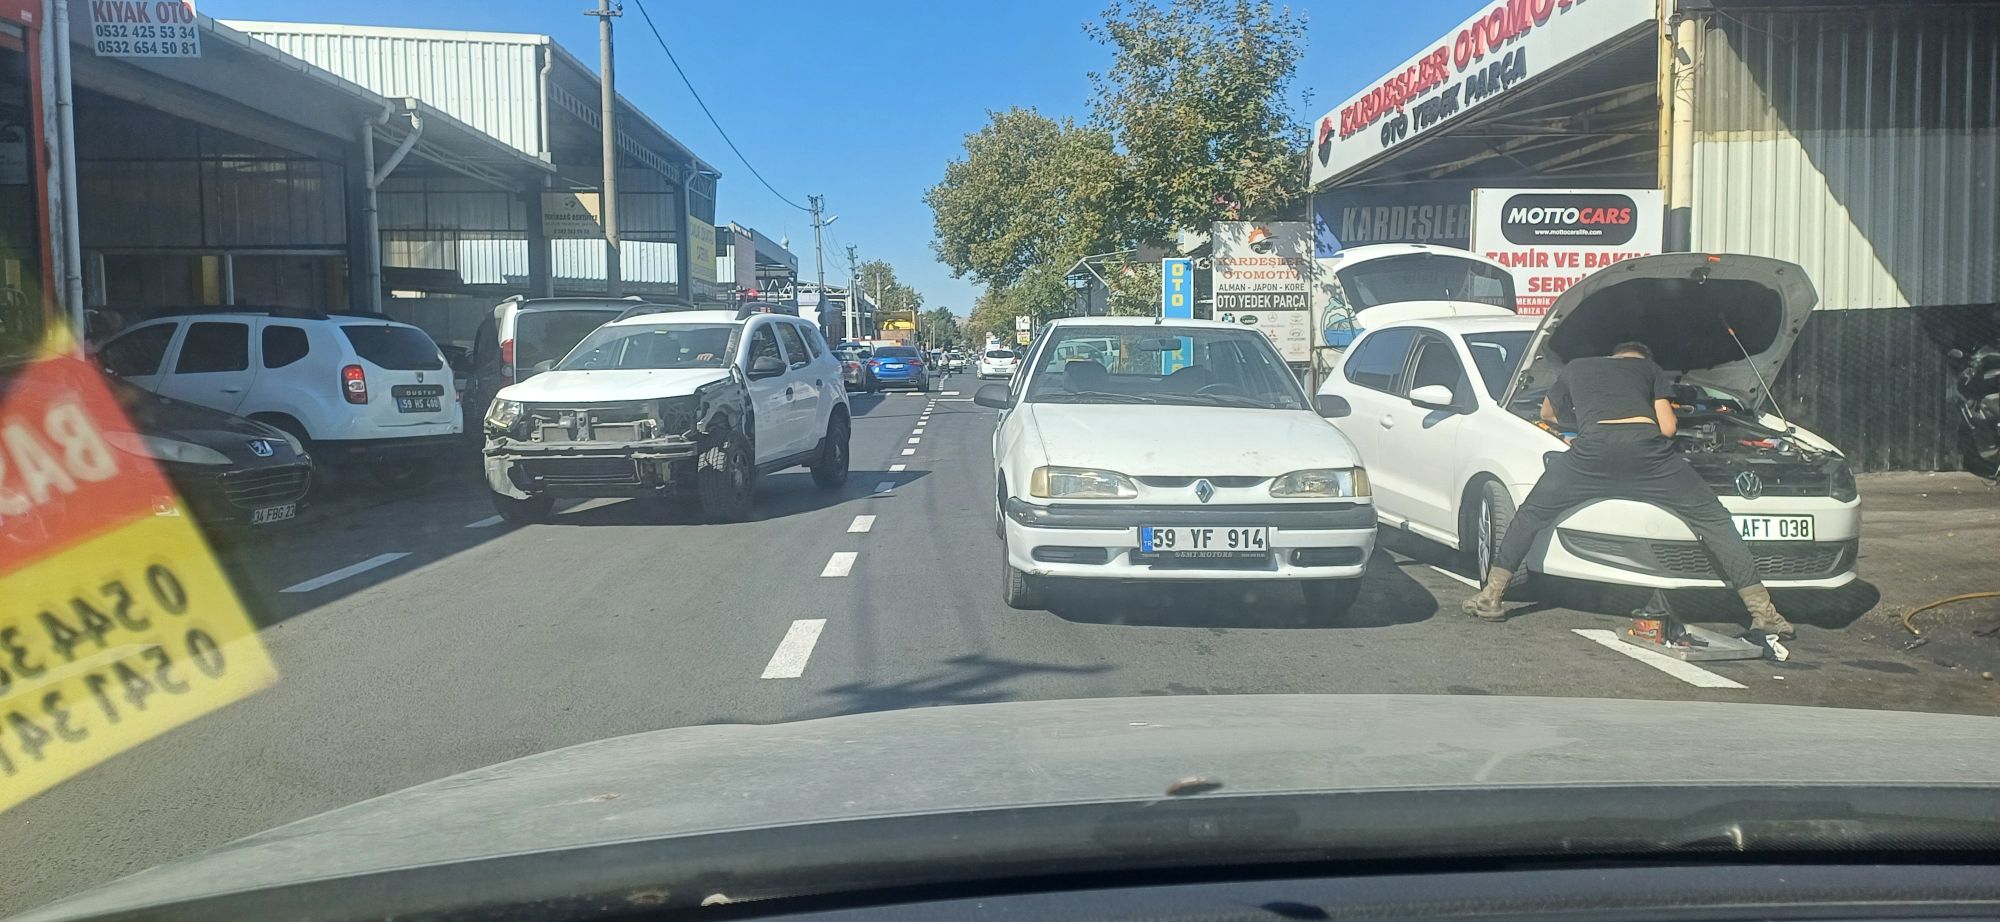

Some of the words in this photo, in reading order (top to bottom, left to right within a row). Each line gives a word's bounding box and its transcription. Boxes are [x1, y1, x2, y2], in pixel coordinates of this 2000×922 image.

[91, 0, 151, 23] KIYAK
[156, 1, 194, 24] OTO
[96, 25, 128, 38] 0532
[132, 26, 156, 38] 425
[160, 26, 176, 39] 53
[179, 26, 195, 39] 34
[97, 41, 130, 53] 0532
[134, 41, 157, 54] 654
[162, 42, 177, 54] 50
[182, 42, 197, 55] 81
[1339, 45, 1450, 140] KARDEŞLER
[1380, 112, 1408, 147] OTO
[1412, 83, 1461, 133] YEDEK
[1465, 46, 1527, 107] PARÇA
[1341, 204, 1469, 242] KARDEŞLER
[1507, 207, 1631, 225] MOTTOCARS
[1534, 228, 1603, 237] www.mottocarslife.com
[1217, 257, 1303, 268] KARDEŞLER
[1486, 248, 1552, 268] TAMİR
[1554, 252, 1580, 268] VE
[1223, 269, 1300, 280] OTOMOTİV
[1528, 274, 1587, 293] SERV
[1171, 263, 1185, 307] OTO
[1284, 283, 1305, 291] KORE
[1217, 295, 1236, 308] OTO
[1238, 295, 1271, 308] YEDEK
[1273, 294, 1306, 311] PARÇA
[266, 507, 284, 521] FBG
[1742, 518, 1771, 537] AFT
[1779, 519, 1809, 538] 038
[1153, 529, 1176, 548] 59
[1190, 529, 1214, 548] YF
[1228, 529, 1264, 548] 914
